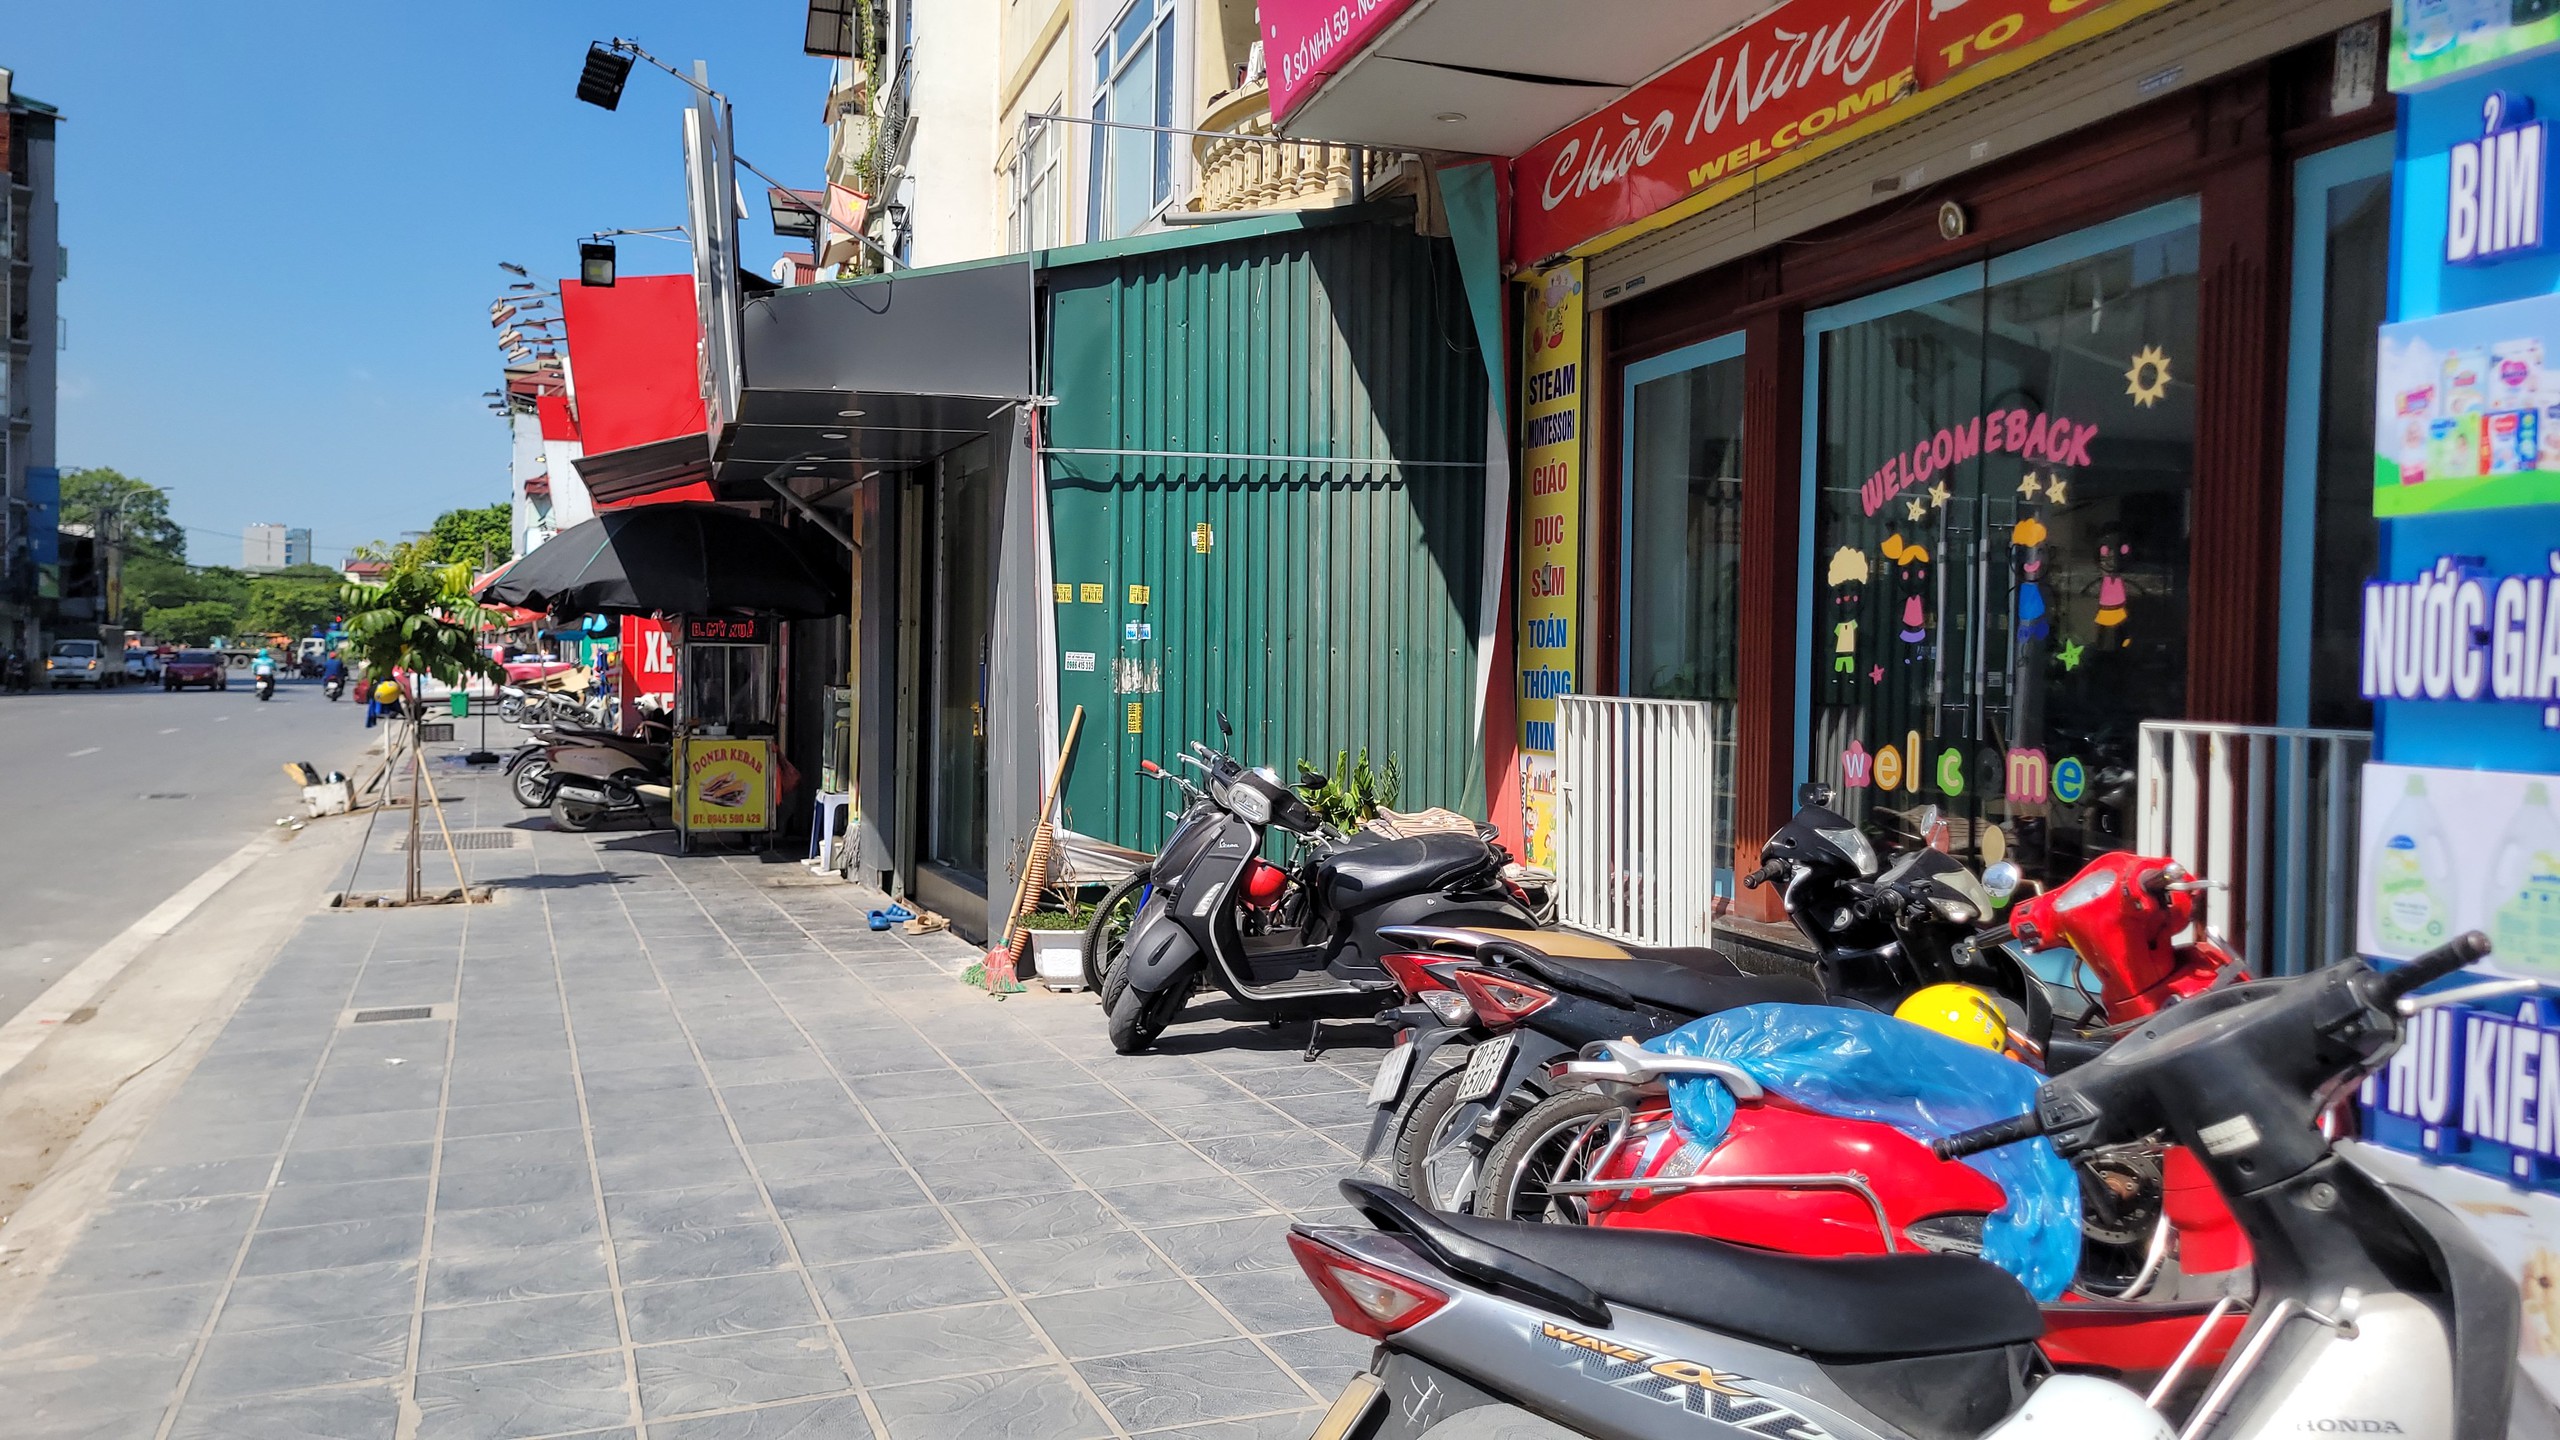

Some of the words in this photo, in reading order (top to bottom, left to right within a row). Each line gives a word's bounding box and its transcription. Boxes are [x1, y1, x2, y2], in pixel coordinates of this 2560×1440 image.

[1293, 36, 1309, 81] SỐ
[1309, 17, 1334, 67] NHÀ
[1333, 5, 1349, 42] 59
[1541, 110, 1674, 211] Chào
[1685, 0, 1903, 144] Mừng
[1688, 65, 1914, 187] WELCOME
[1939, 13, 2024, 68] TO
[2447, 92, 2544, 262] BỈM
[1528, 363, 1576, 406] STEAM
[1527, 408, 1575, 450] MONTESSORI
[1532, 458, 1568, 497] GIÁO
[1534, 514, 1564, 552] DỤC
[1528, 612, 1567, 649] TOÁN
[2362, 556, 2486, 699] NƯỚC
[1522, 664, 1572, 700] THÔNG
[692, 748, 727, 775] DONER
[2361, 1007, 2450, 1149] HỤ
[1543, 1322, 1652, 1363] WAVE
